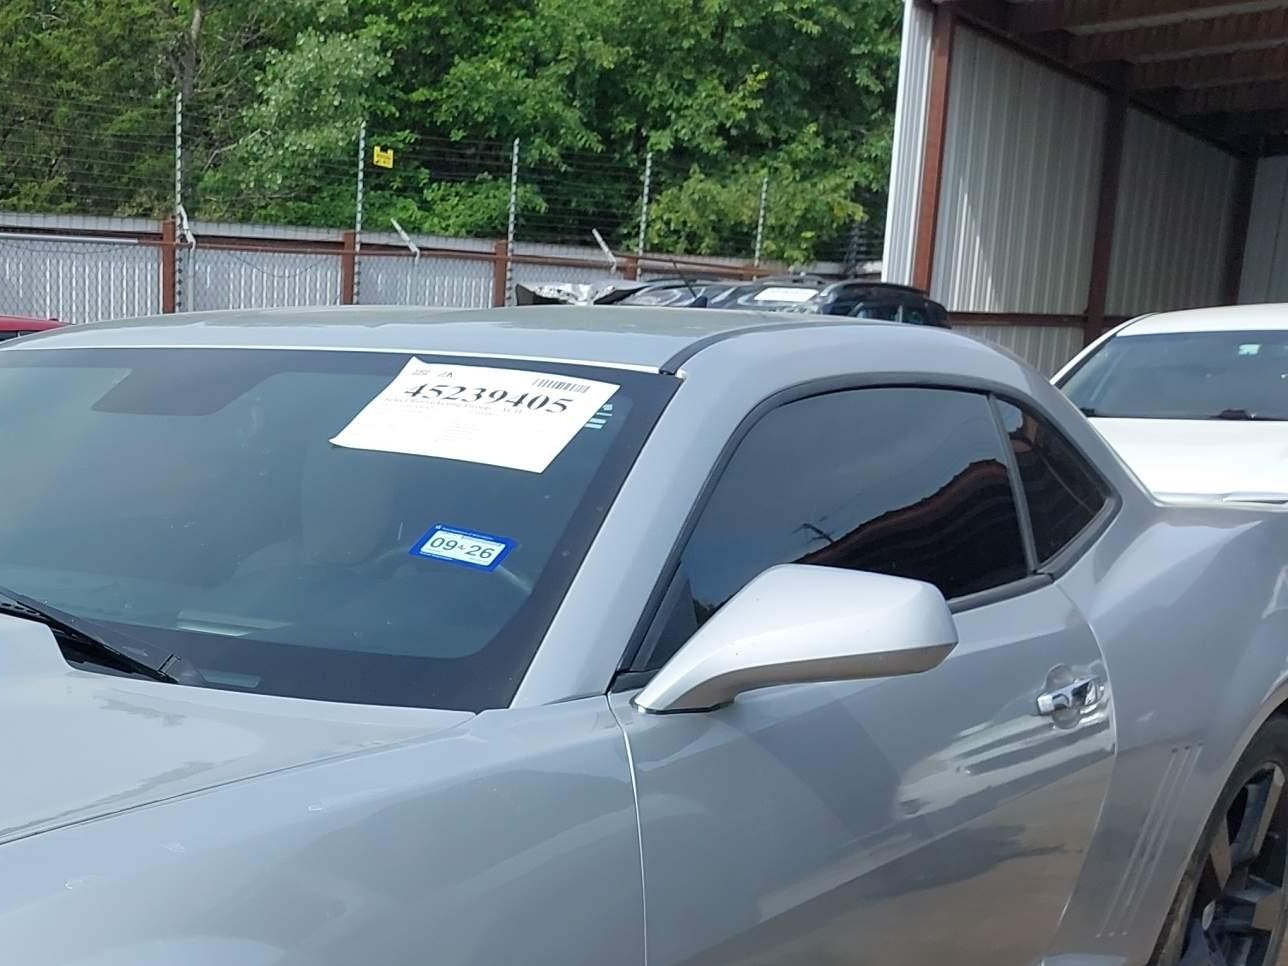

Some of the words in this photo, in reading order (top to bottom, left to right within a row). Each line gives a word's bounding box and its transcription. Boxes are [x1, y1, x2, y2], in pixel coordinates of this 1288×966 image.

[404, 382, 576, 415] 45239405
[430, 536, 459, 551] 09
[465, 544, 495, 559] 26
